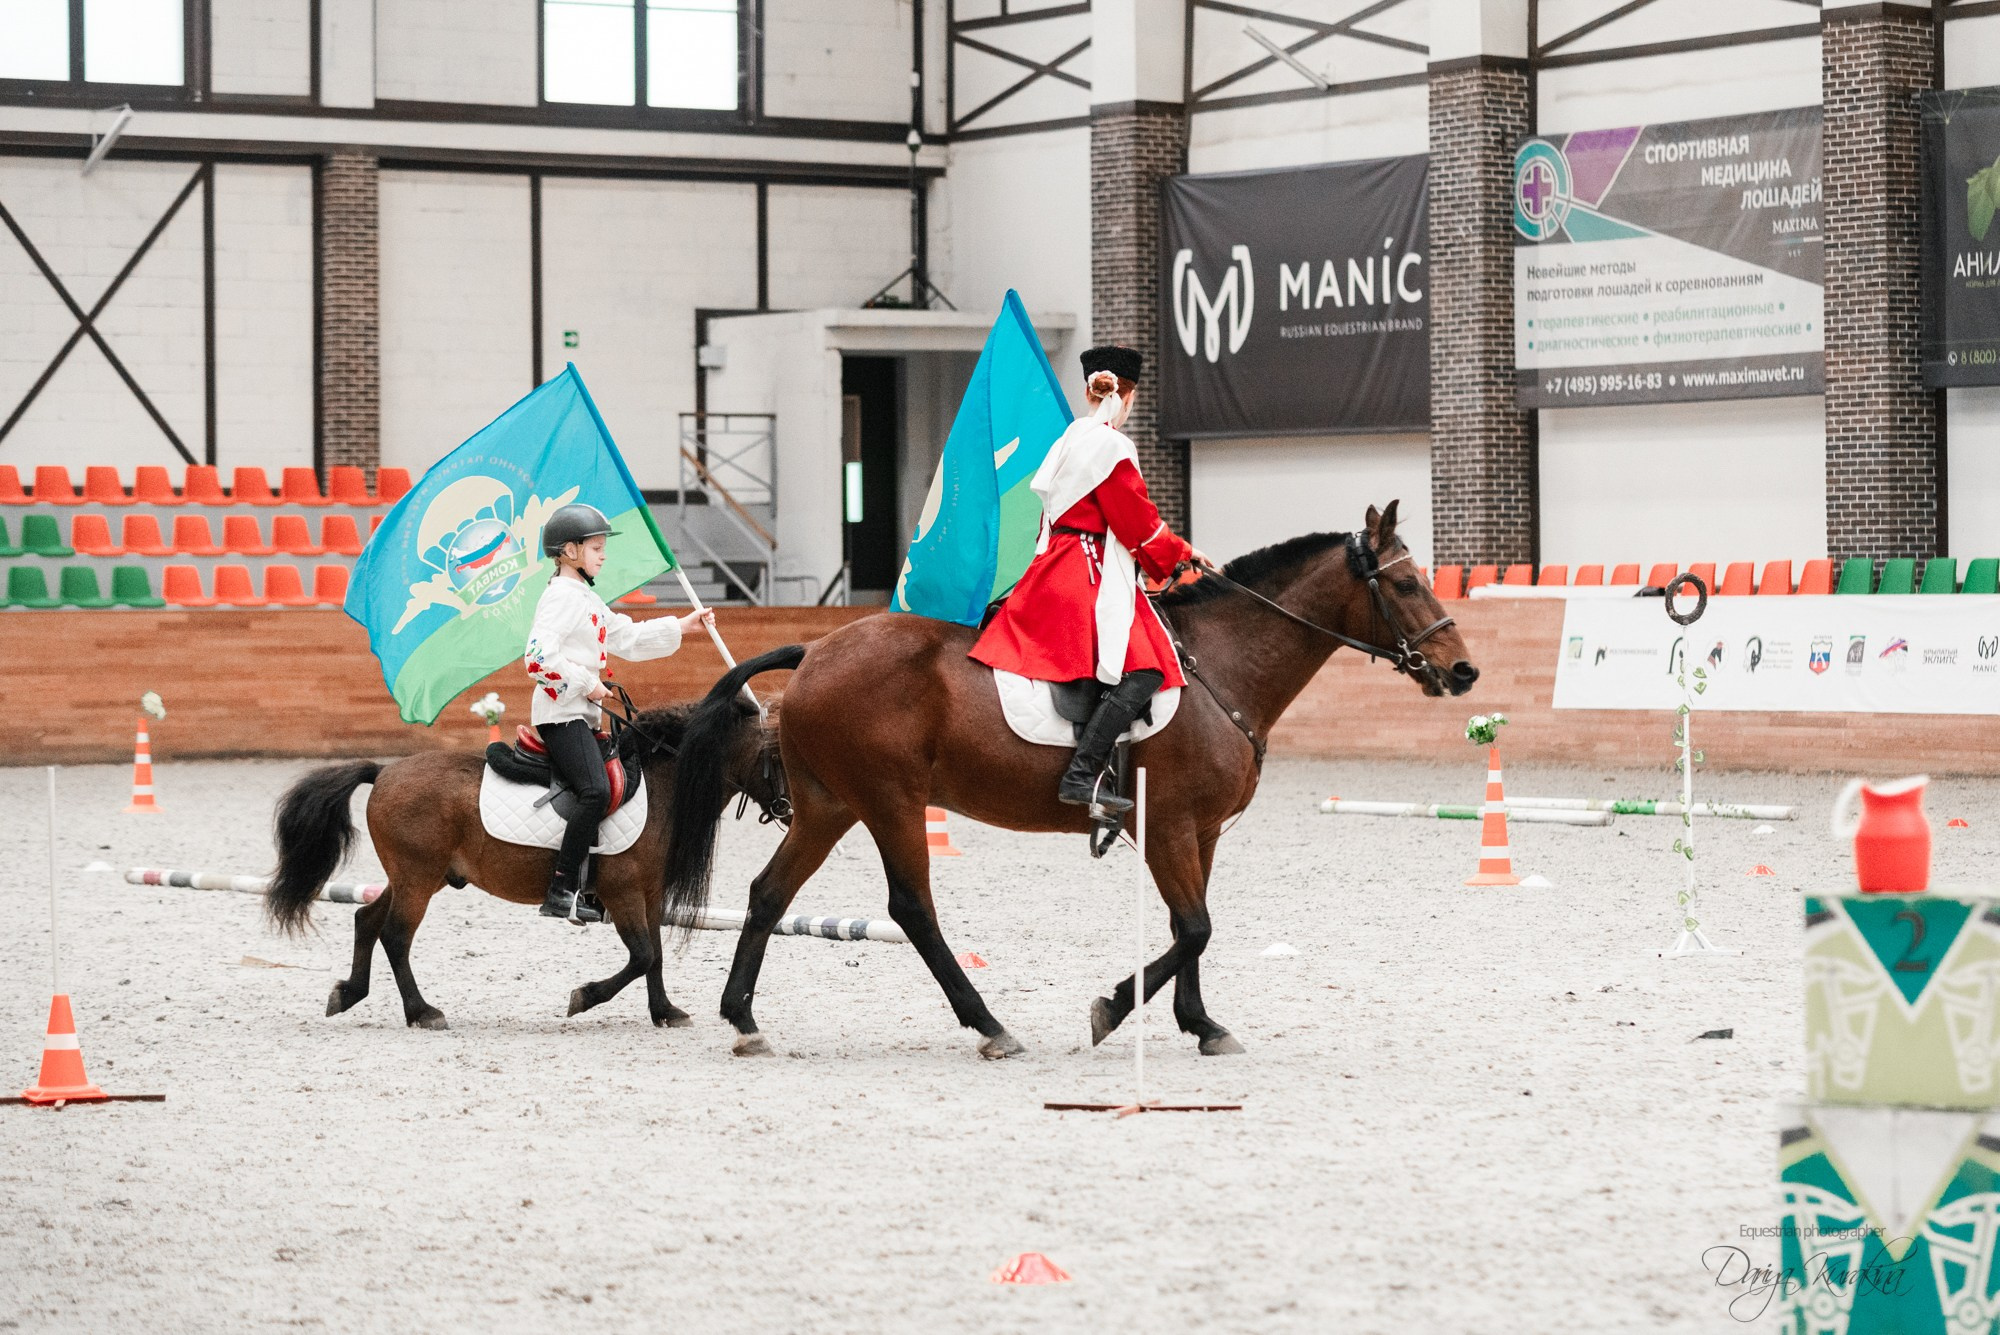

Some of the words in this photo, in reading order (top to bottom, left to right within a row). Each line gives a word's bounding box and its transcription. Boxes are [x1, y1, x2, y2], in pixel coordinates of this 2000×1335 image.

[1644, 134, 1750, 165] СПОРТИВНАЯ
[1701, 157, 1792, 188] МЕДИЦИНА
[1740, 178, 1823, 211] ЛОШАДЕЙ
[1772, 216, 1819, 235] MAXIMA
[1527, 262, 1587, 280] Новейшие
[1590, 260, 1637, 277] методы
[1527, 286, 1594, 303] подготовки
[1597, 278, 1651, 297] лошадей
[1655, 283, 1663, 293] к
[1665, 273, 1764, 295] соревнованиям
[1279, 324, 1322, 338] RUSSIAN
[1323, 320, 1387, 336] EQUESTRIAN
[1387, 317, 1423, 332] BRAND
[1537, 311, 1639, 332] терапевтические
[1653, 301, 1775, 326] реабилитационные
[1536, 334, 1640, 353] диагностические
[1653, 322, 1802, 348] физиотерапевтические
[1545, 377, 1562, 394] +7
[1564, 375, 1598, 397] (495)
[1600, 372, 1663, 392] 995-16-83
[1682, 364, 1805, 388] www.maximavet.ru
[1922, 655, 1958, 665] ЭКЛИПС
[1923, 648, 1959, 656] КРЫЛАТЫЙ
[1892, 910, 1928, 973] 2
